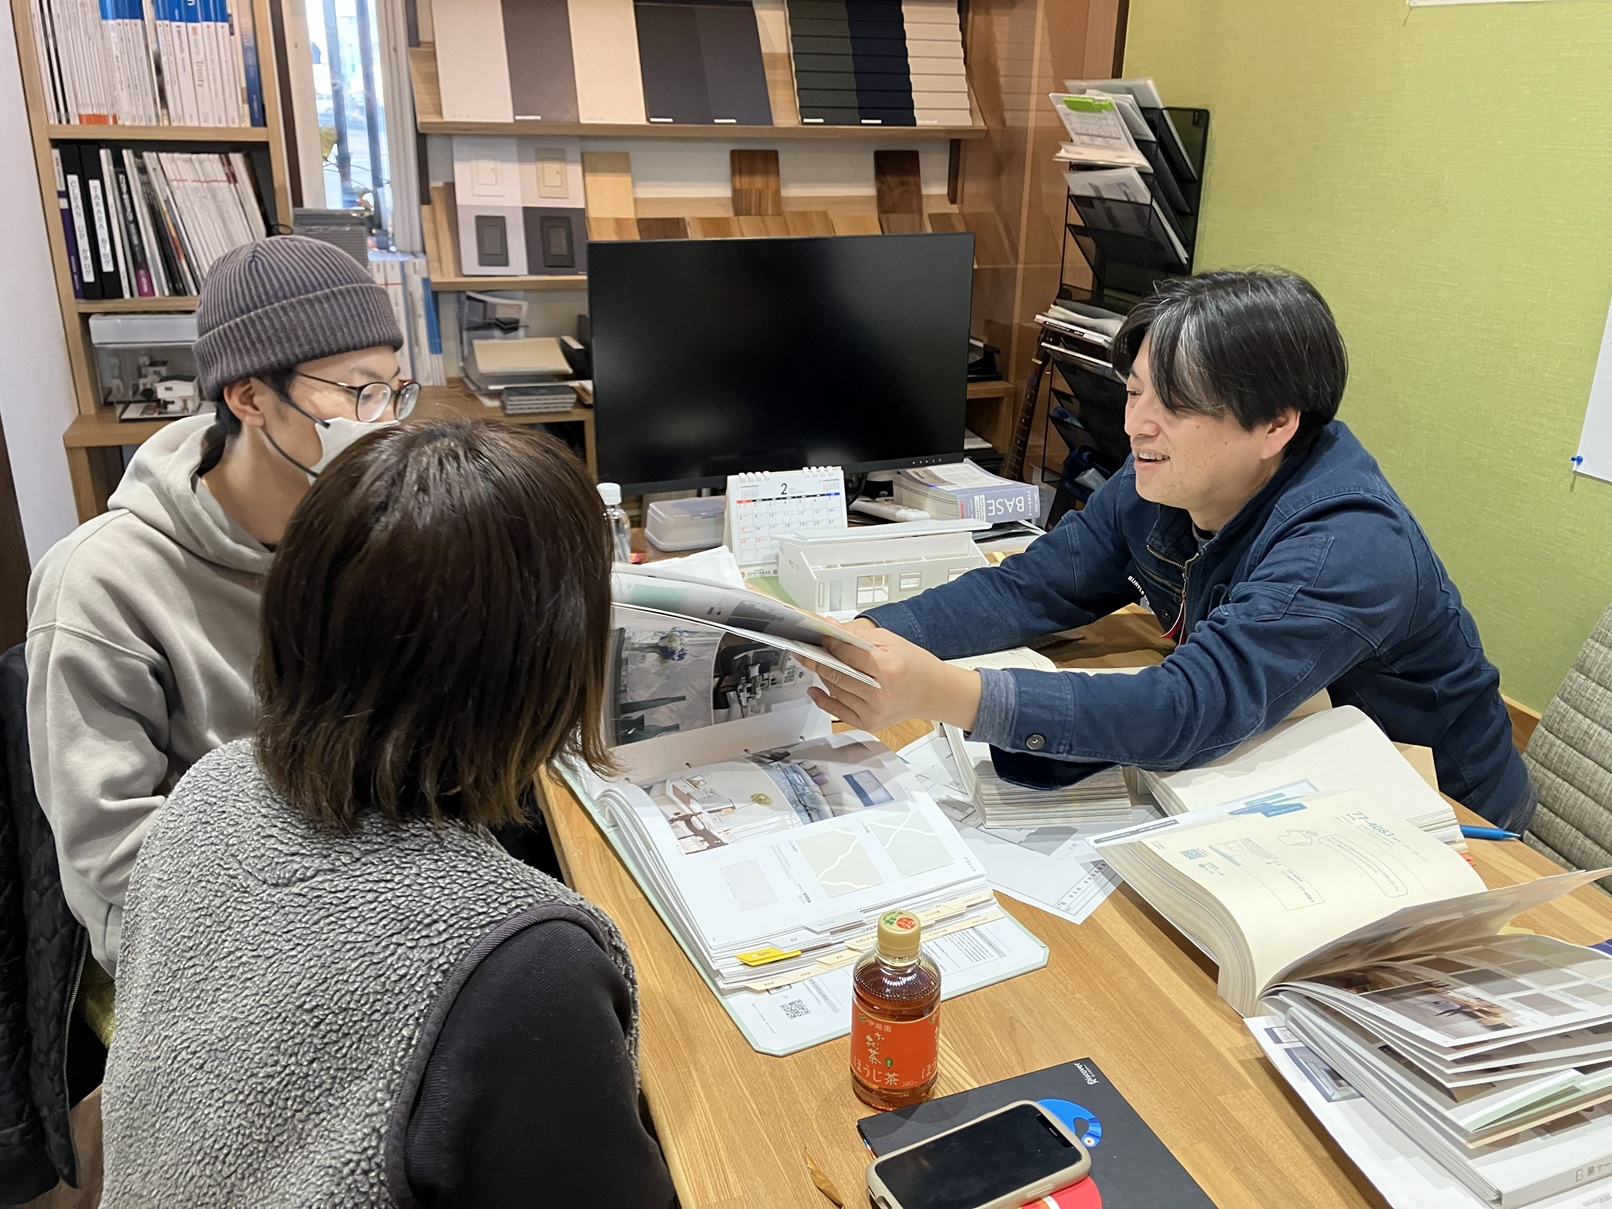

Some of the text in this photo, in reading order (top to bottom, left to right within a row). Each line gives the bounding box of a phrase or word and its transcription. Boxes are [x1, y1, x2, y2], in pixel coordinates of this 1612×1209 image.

[781, 483, 788, 495] 2
[986, 495, 1024, 517] BASE
[853, 1055, 900, 1086] ほうじ茶
